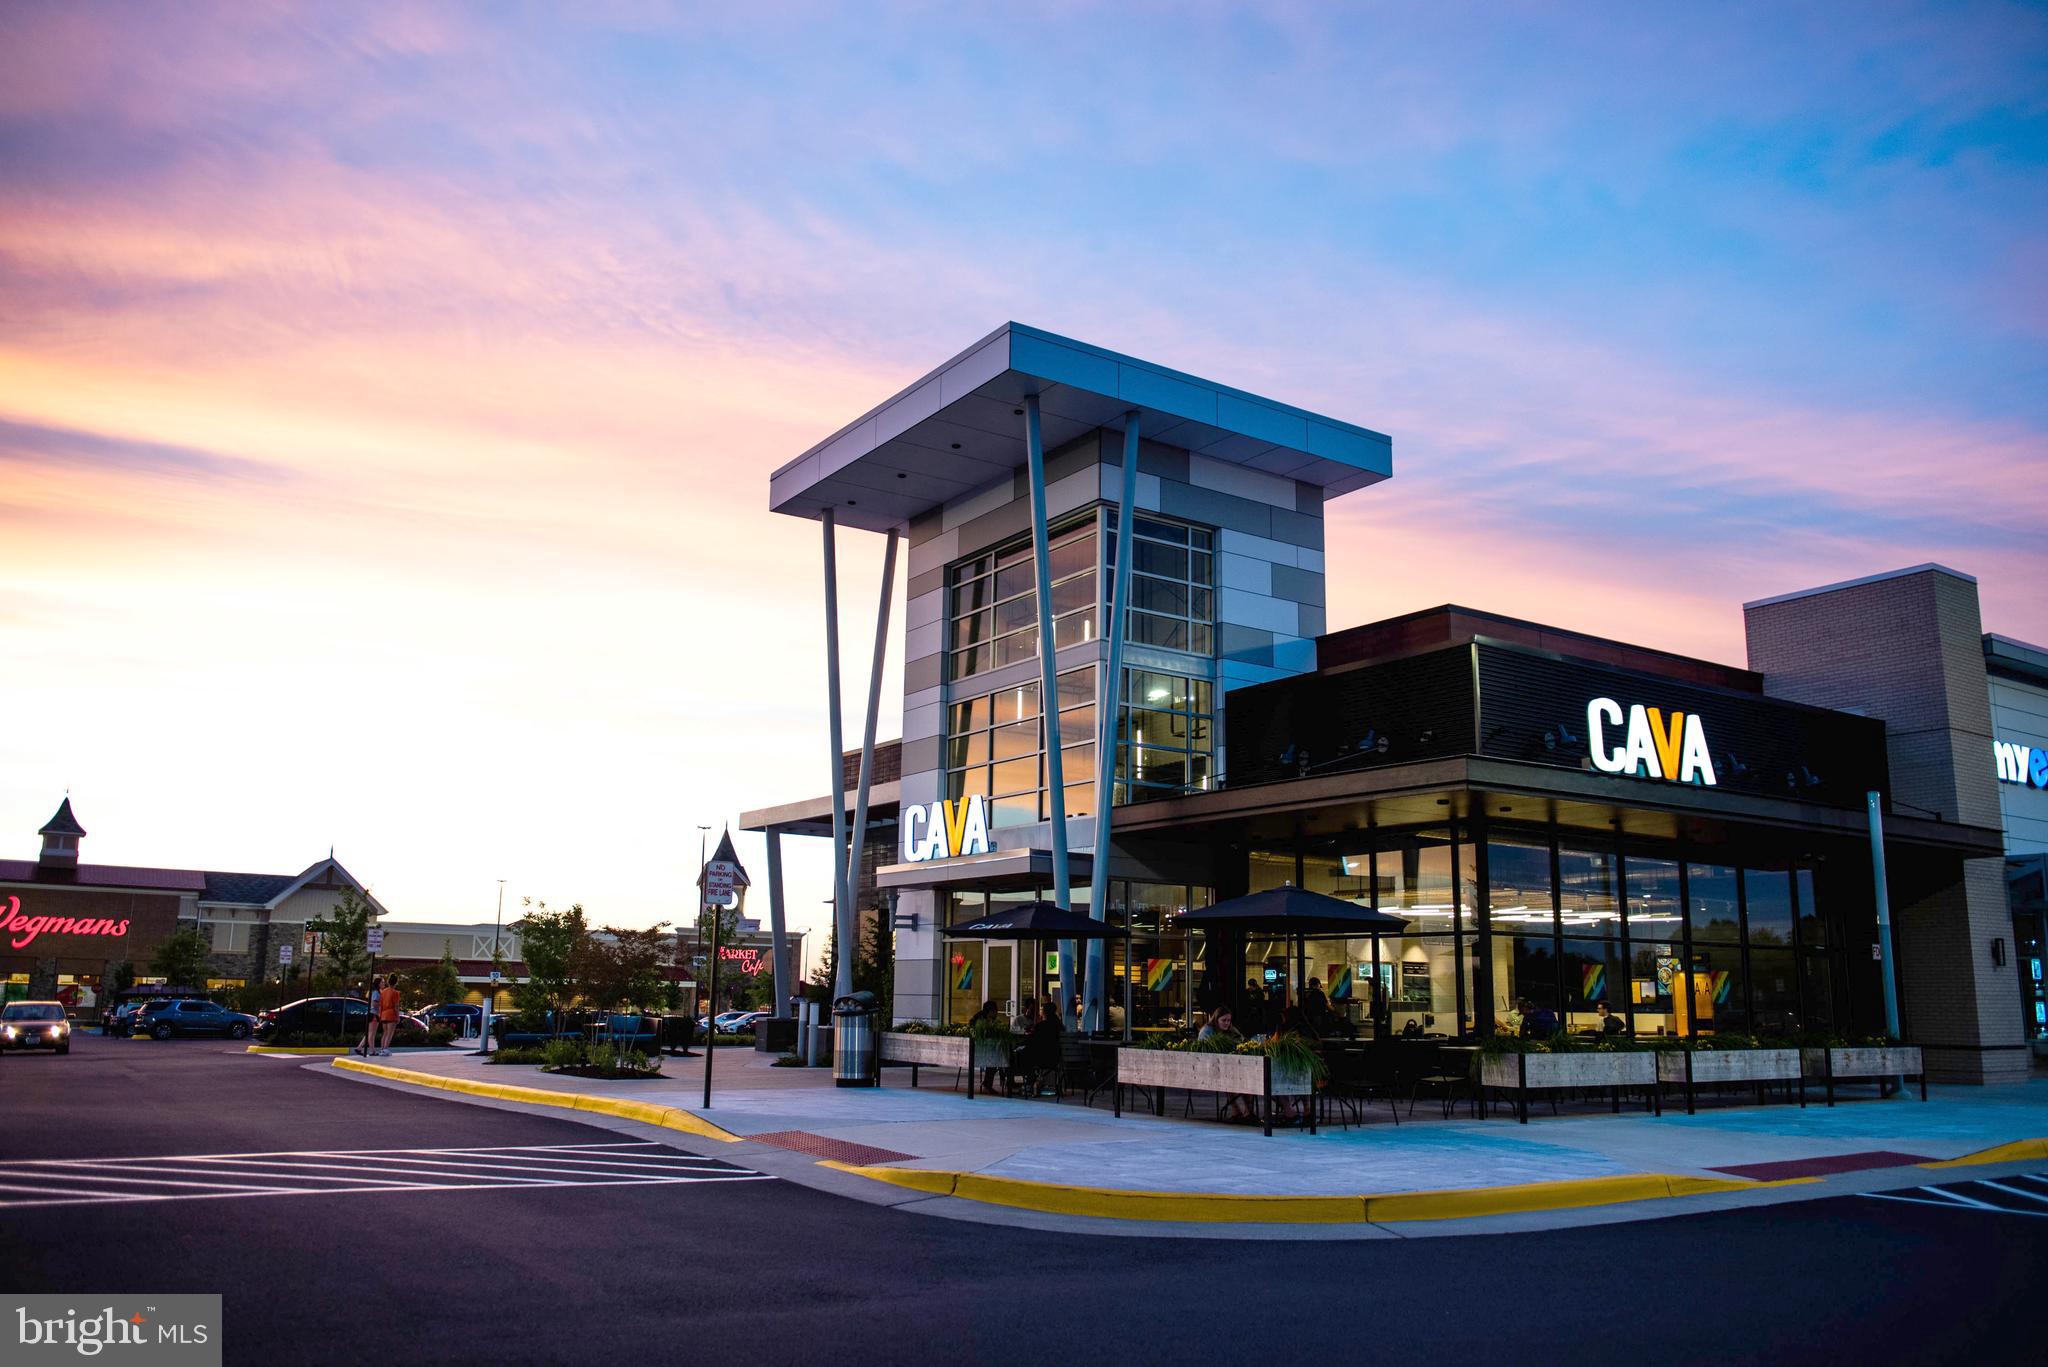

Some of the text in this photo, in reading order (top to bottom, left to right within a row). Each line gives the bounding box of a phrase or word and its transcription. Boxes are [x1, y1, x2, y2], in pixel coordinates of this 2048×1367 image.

[1588, 697, 1717, 785] CAVA
[905, 794, 990, 862] CAVA
[709, 870, 732, 878] PARKING
[720, 889, 732, 897] LANE
